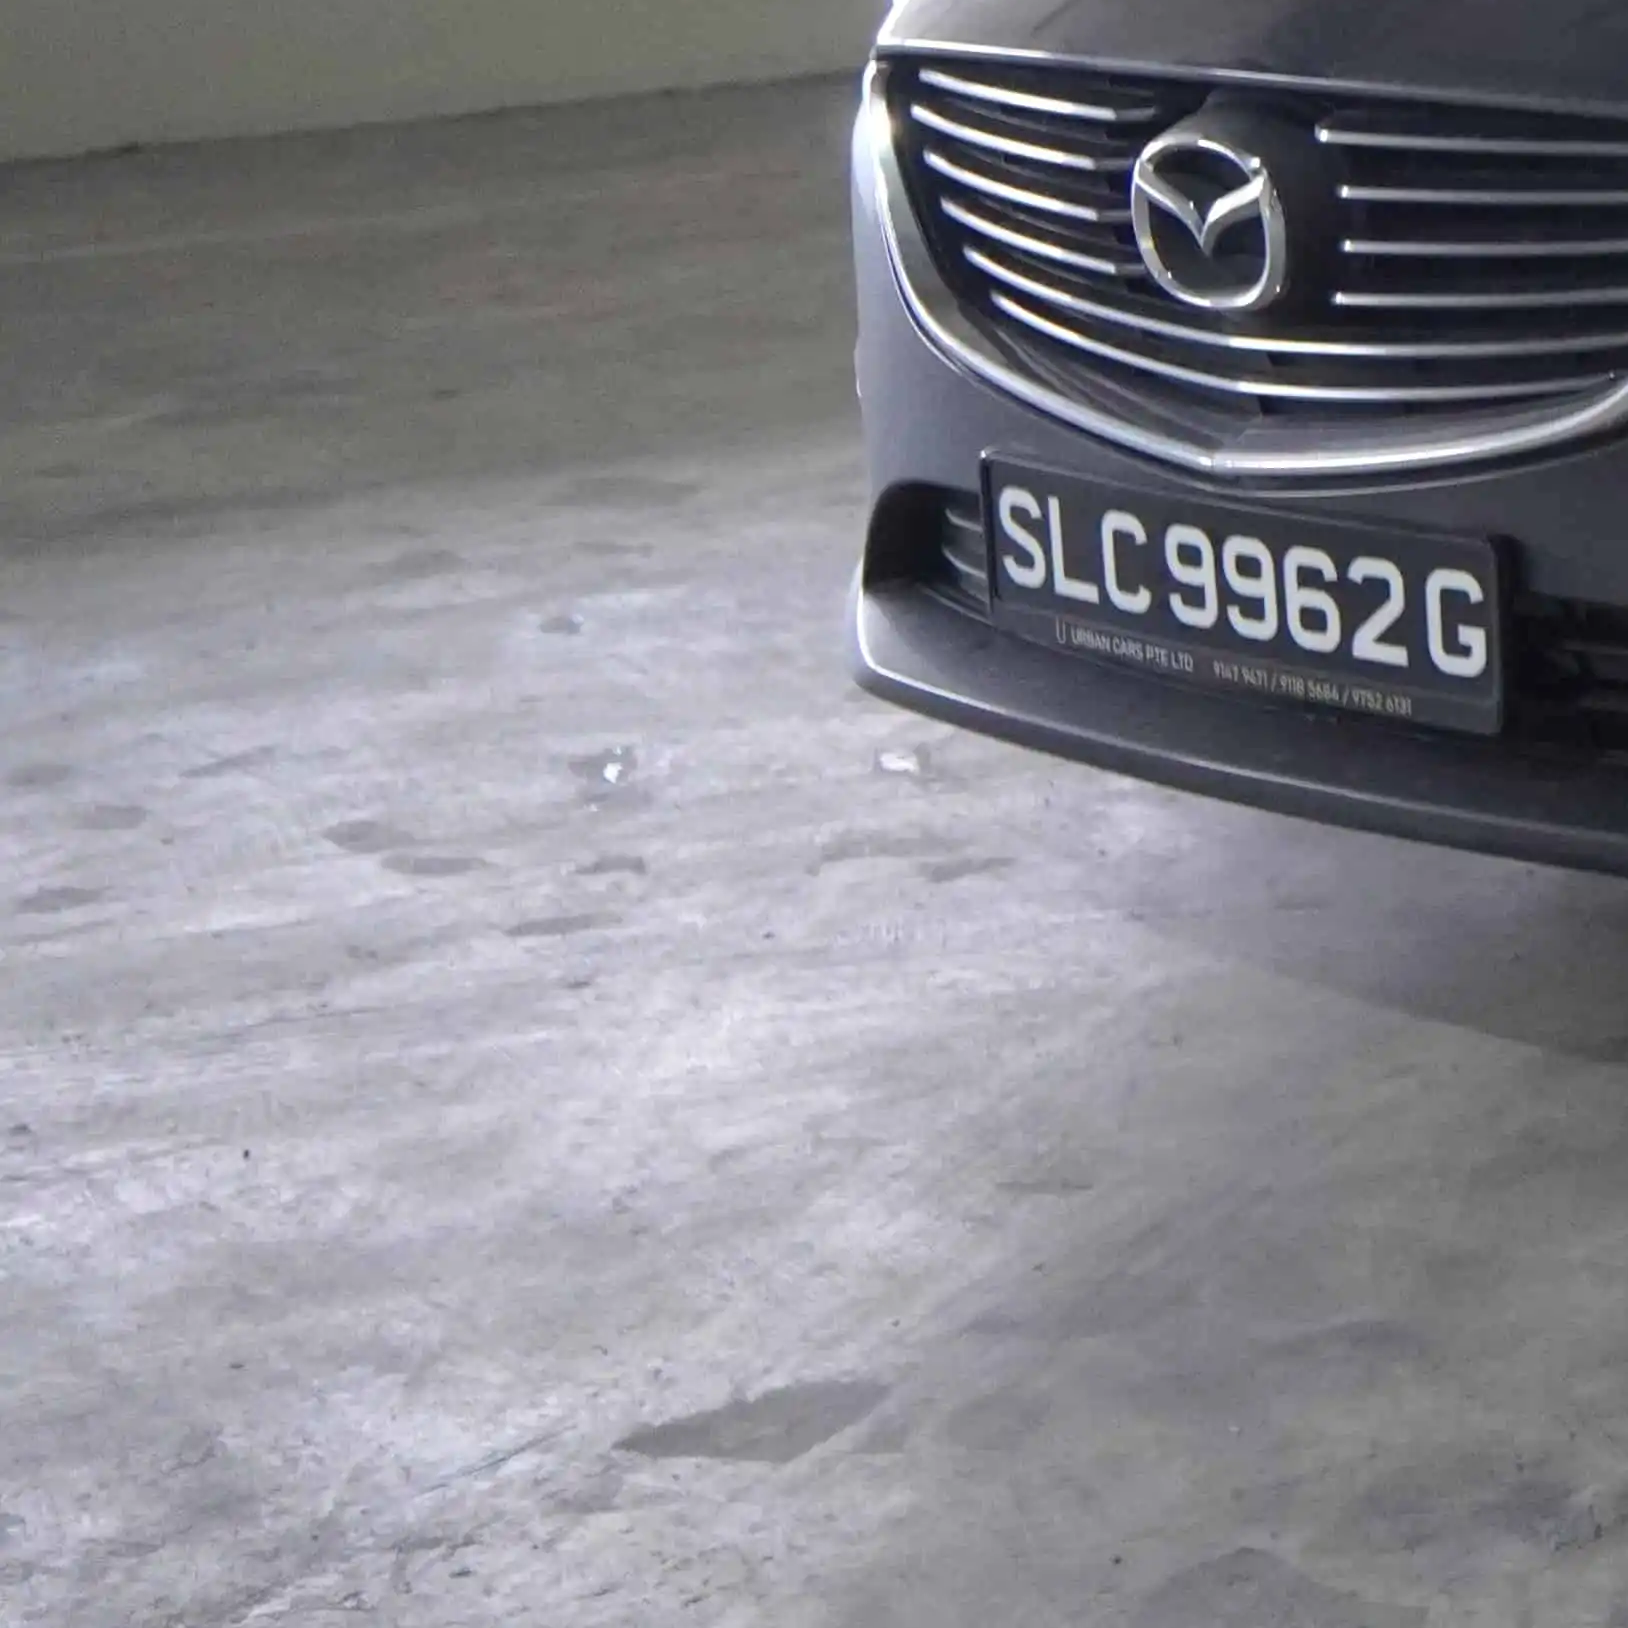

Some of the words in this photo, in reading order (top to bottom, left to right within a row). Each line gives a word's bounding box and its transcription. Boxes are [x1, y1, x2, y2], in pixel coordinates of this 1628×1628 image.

[1070, 627, 1111, 653] URBAN
[1112, 636, 1144, 662] CARS
[1145, 643, 1169, 668] PTE
[1171, 651, 1194, 672] LTD
